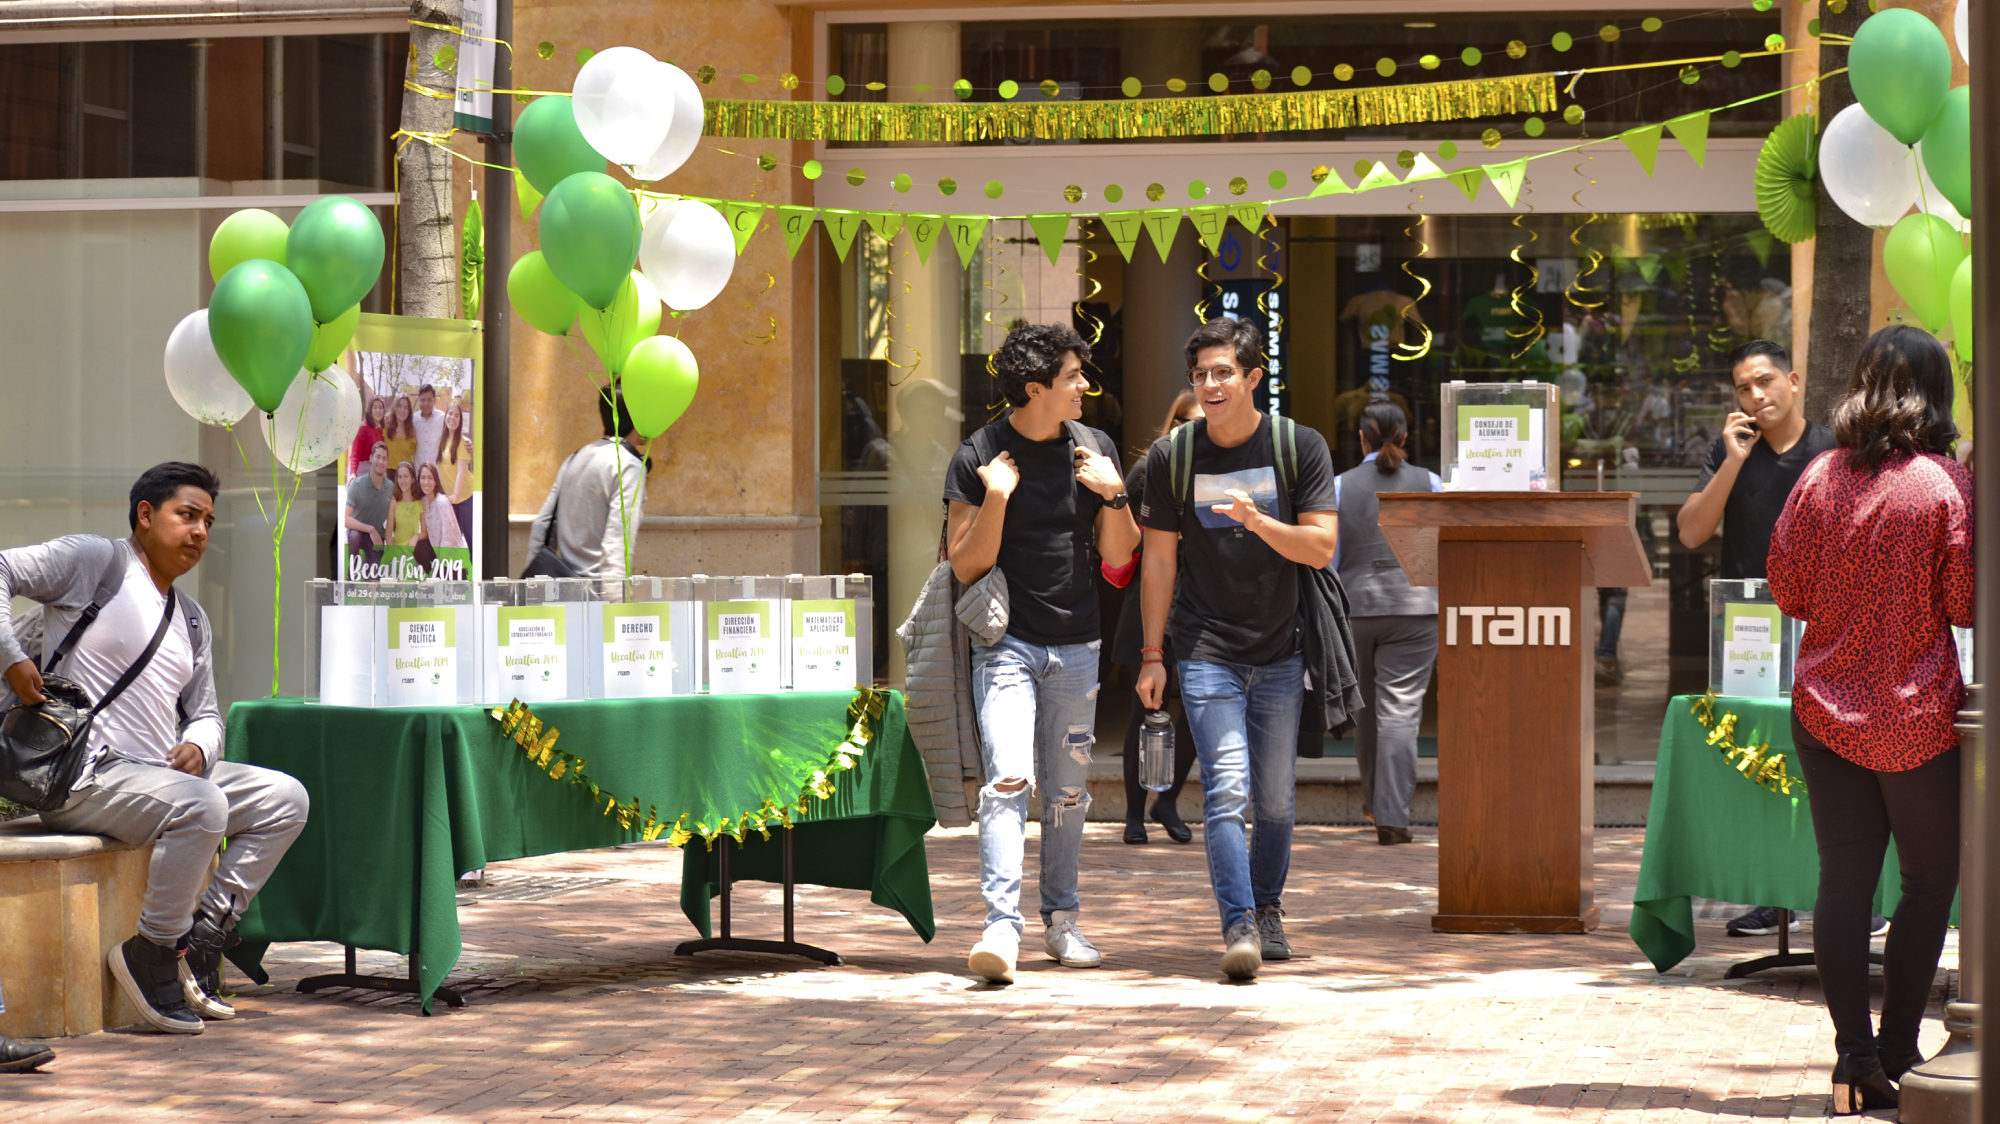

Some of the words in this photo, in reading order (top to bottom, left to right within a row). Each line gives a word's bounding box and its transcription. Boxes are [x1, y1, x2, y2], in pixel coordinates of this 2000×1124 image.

[1268, 292, 1280, 416] SAMSUN
[1474, 420, 1503, 428] CONSEJO
[1505, 420, 1513, 428] DE
[1466, 448, 1502, 459] Becatlón
[1505, 448, 1522, 457] 2019
[349, 554, 426, 581] Becatlón
[431, 558, 463, 581] 2019
[346, 589, 357, 598] del
[358, 590, 368, 598] 29
[724, 615, 754, 625] DIRECCIÓN
[805, 615, 843, 623] MATEMÁTICAS
[410, 624, 434, 632] CIENCIA
[622, 623, 653, 633] DERECHO
[723, 626, 756, 634] FINANCIERA
[1735, 625, 1769, 633] ADMINISTRACIÓN
[409, 633, 436, 643] POLÍTICA
[835, 645, 849, 654] 2019
[505, 654, 540, 667] Becatlón
[611, 650, 645, 663] Becatlón
[649, 650, 664, 660] 2019
[396, 657, 430, 670] Becatlón
[434, 657, 448, 667] 2019
